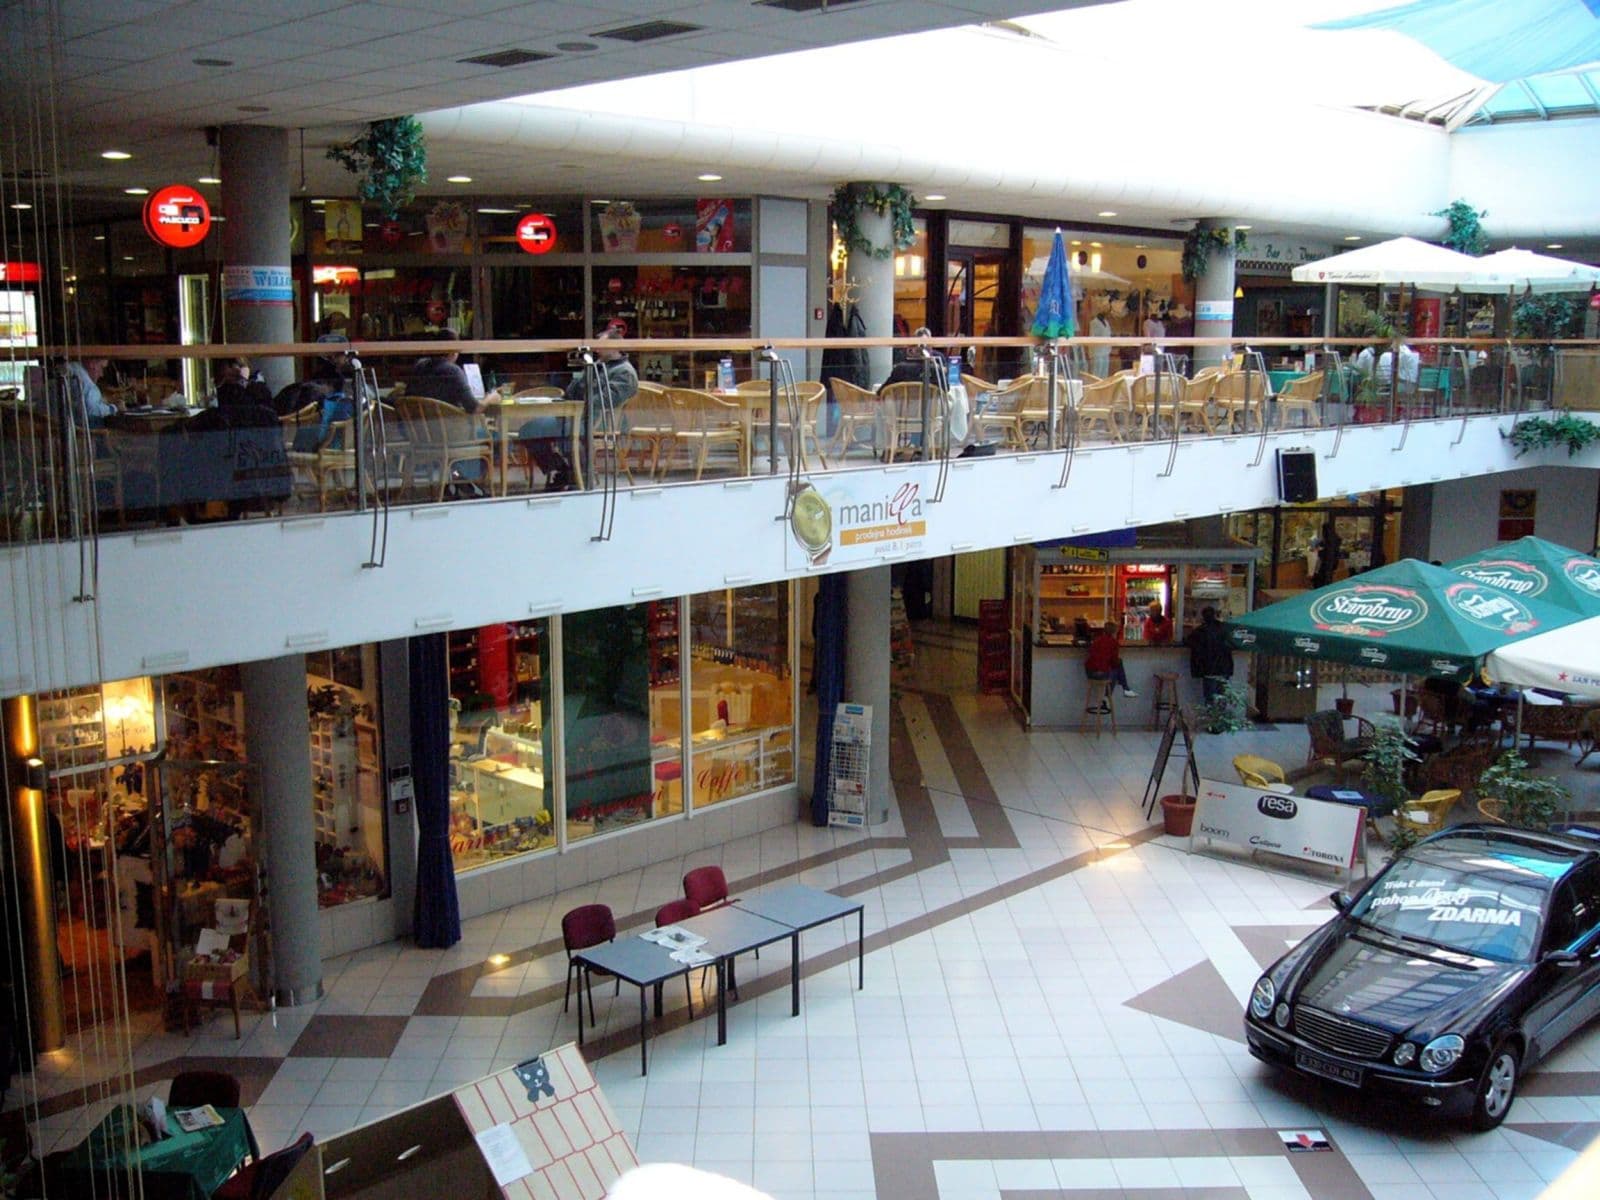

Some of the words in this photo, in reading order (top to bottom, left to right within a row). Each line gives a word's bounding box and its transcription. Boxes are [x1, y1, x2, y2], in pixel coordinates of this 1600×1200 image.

[840, 482, 922, 526] manilla
[1326, 596, 1413, 624] Starobrno
[1261, 795, 1295, 814] resa
[1200, 822, 1230, 839] boom
[1427, 906, 1521, 927] ZDARMA
